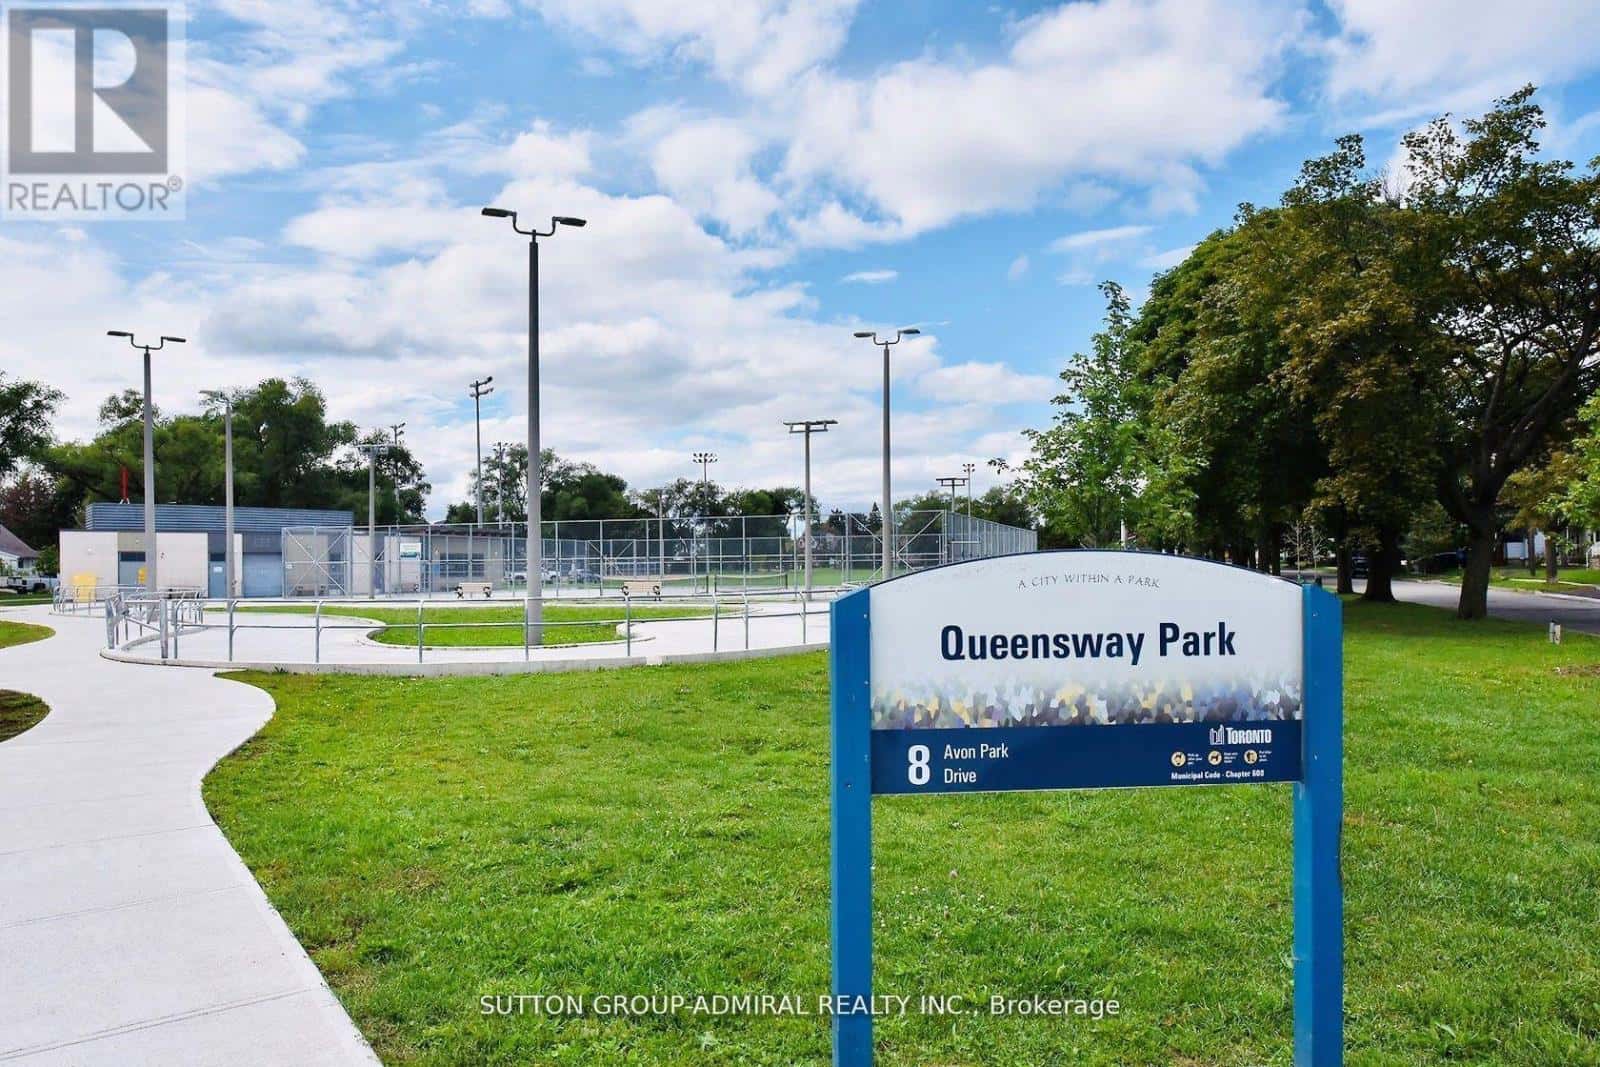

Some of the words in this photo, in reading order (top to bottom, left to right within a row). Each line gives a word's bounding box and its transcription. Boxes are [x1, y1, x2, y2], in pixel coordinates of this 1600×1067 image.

[1018, 579, 1027, 590] A
[1031, 575, 1059, 587] CITY
[1064, 573, 1110, 584] WITHIN
[1114, 575, 1122, 584] A
[1128, 575, 1160, 588] PARK
[941, 624, 1145, 666] Queensway
[1159, 621, 1236, 657] Park
[1227, 728, 1272, 745] TORONTO
[943, 744, 976, 760] Avon
[980, 743, 1009, 759] Park
[907, 745, 931, 786] 8
[943, 768, 977, 784] Drive
[1171, 771, 1204, 782] Municipal
[1205, 770, 1221, 779] Code
[1225, 770, 1251, 780] Chapter
